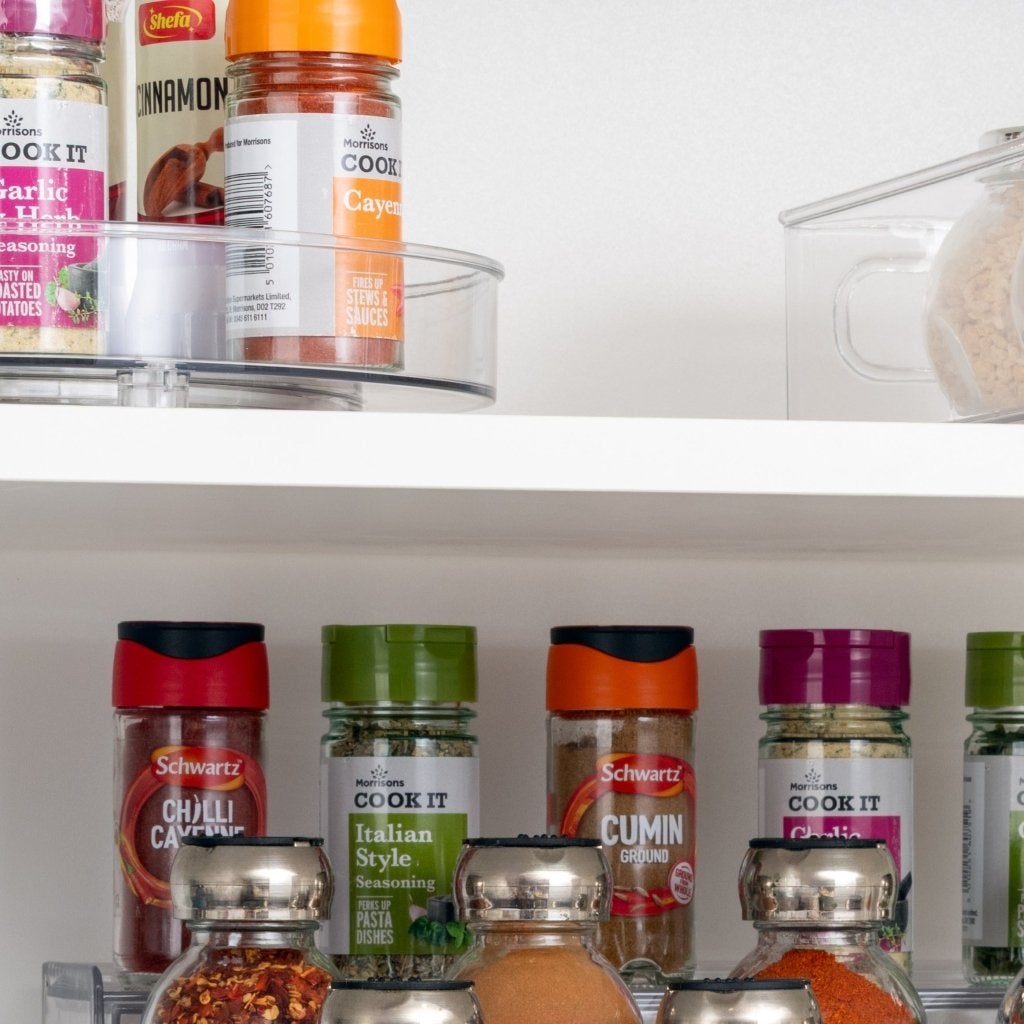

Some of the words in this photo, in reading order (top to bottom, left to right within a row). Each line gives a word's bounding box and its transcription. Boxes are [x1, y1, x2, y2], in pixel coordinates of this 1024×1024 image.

[149, 11, 191, 31] Shefa
[136, 77, 228, 117] CINNAMON
[0, 128, 42, 137] rrisons
[1, 142, 61, 161] OOK
[66, 144, 87, 163] IT
[343, 139, 389, 151] Morrisons
[341, 154, 397, 177] COOK
[343, 189, 402, 220] Cayen
[0, 238, 76, 258] easoning
[0, 270, 19, 282] ASTY
[21, 270, 33, 282] ON
[352, 277, 373, 289] FIRES
[374, 278, 384, 290] UP
[0, 282, 41, 300] ASTED
[346, 288, 380, 306] STEWS
[0, 301, 42, 317] TATOES
[346, 306, 389, 327] SAUCES
[155, 756, 241, 776] Schwartz
[601, 763, 681, 783] Schwartz
[355, 779, 405, 788] Morrisons
[790, 782, 838, 791] Morrisons
[162, 793, 234, 824] CHILLI
[354, 792, 422, 808] COOK
[427, 792, 448, 808] IT
[788, 795, 855, 812] COOK
[859, 795, 881, 812] IT
[355, 823, 433, 843] Italian
[600, 814, 683, 847] CUMIN
[356, 847, 412, 873] Style
[620, 849, 669, 864] GROUND
[356, 875, 436, 893] Seasoning
[358, 900, 379, 911] PERKS
[381, 900, 392, 911] UP
[356, 911, 393, 928] PASTA
[356, 929, 394, 945] DISHES
